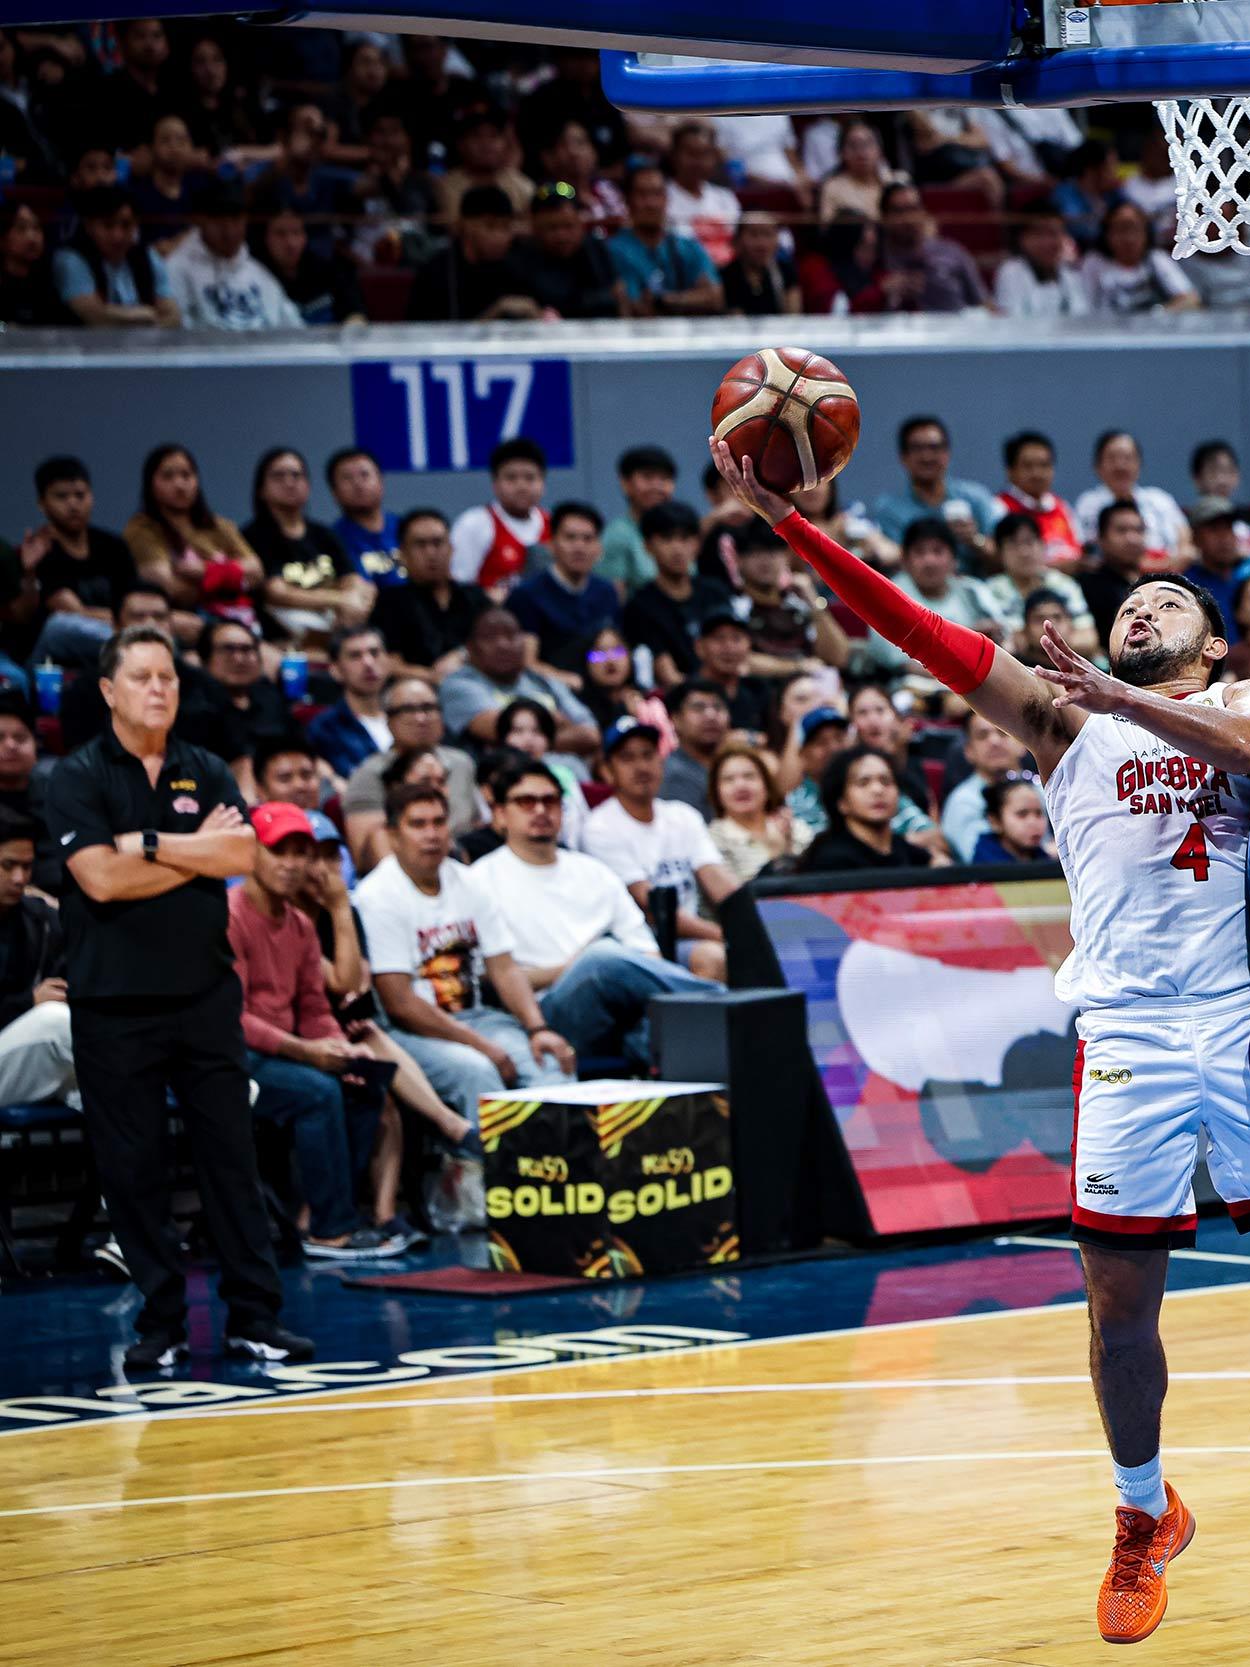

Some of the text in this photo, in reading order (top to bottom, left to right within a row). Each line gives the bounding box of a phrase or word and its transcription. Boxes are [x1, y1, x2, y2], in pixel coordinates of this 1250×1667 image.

[390, 364, 534, 470] 117
[1129, 793, 1173, 815] SAN
[1170, 822, 1211, 882] 4
[486, 1165, 733, 1225] SOLID SOLID
